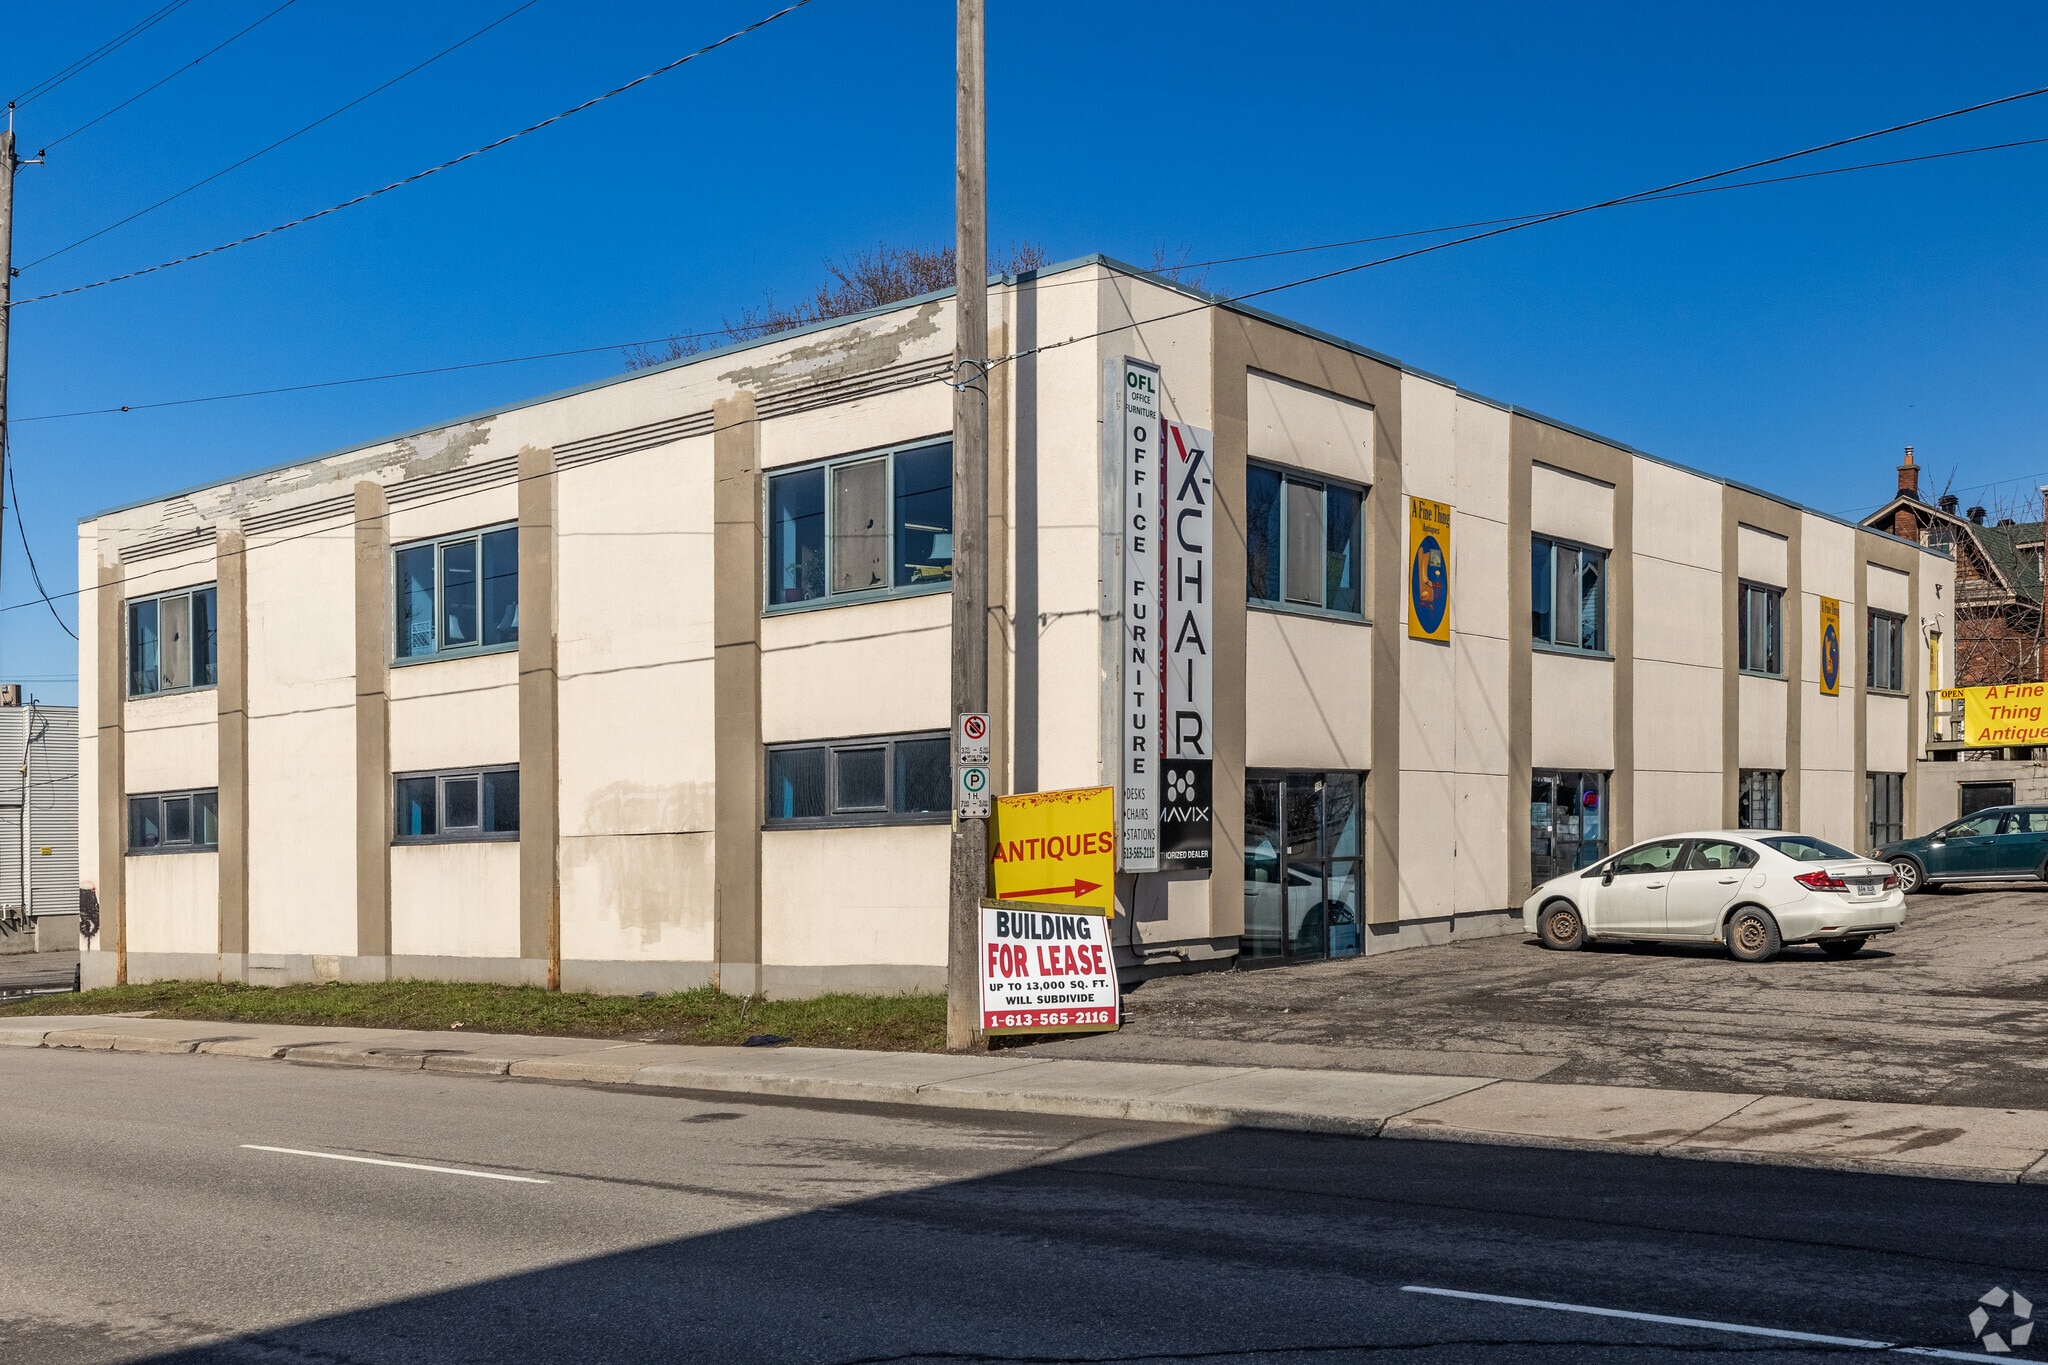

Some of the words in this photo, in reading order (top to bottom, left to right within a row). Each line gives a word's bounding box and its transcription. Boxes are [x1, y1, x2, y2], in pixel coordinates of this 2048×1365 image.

[1127, 372, 1155, 394] OFL
[1131, 392, 1151, 404] OFFICE
[1126, 404, 1156, 419] FURNITURE
[1133, 426, 1147, 553] OFFICE
[1412, 500, 1417, 517] A
[1419, 501, 1432, 521] Fine
[1434, 504, 1450, 528] Thing
[1132, 581, 1146, 773] FURNITURE
[1941, 689, 1964, 698] OPEN
[1985, 686, 1998, 699] A
[2004, 685, 2044, 699] Fine
[1989, 705, 2041, 721] Thing
[1126, 788, 1145, 800] DESKS
[1126, 808, 1148, 820] CHAIRS
[1126, 829, 1155, 840] STATIONS
[991, 831, 1112, 864] ANTIQUES
[1160, 851, 1187, 859] THORIZED
[1188, 850, 1209, 859] DEALER
[997, 911, 1091, 940] BUILDING
[988, 943, 1029, 978] FOR
[1036, 944, 1107, 976] LEASE
[989, 983, 1003, 991] UP
[1008, 982, 1022, 991] TO
[1027, 981, 1065, 991] 13,000
[1070, 980, 1088, 990] SQ.
[1092, 980, 1109, 988] FT.
[1006, 996, 1032, 1005] WILL
[1037, 994, 1095, 1004] SUBDIVIDE
[991, 1011, 1109, 1027] 1-613-565-2116
